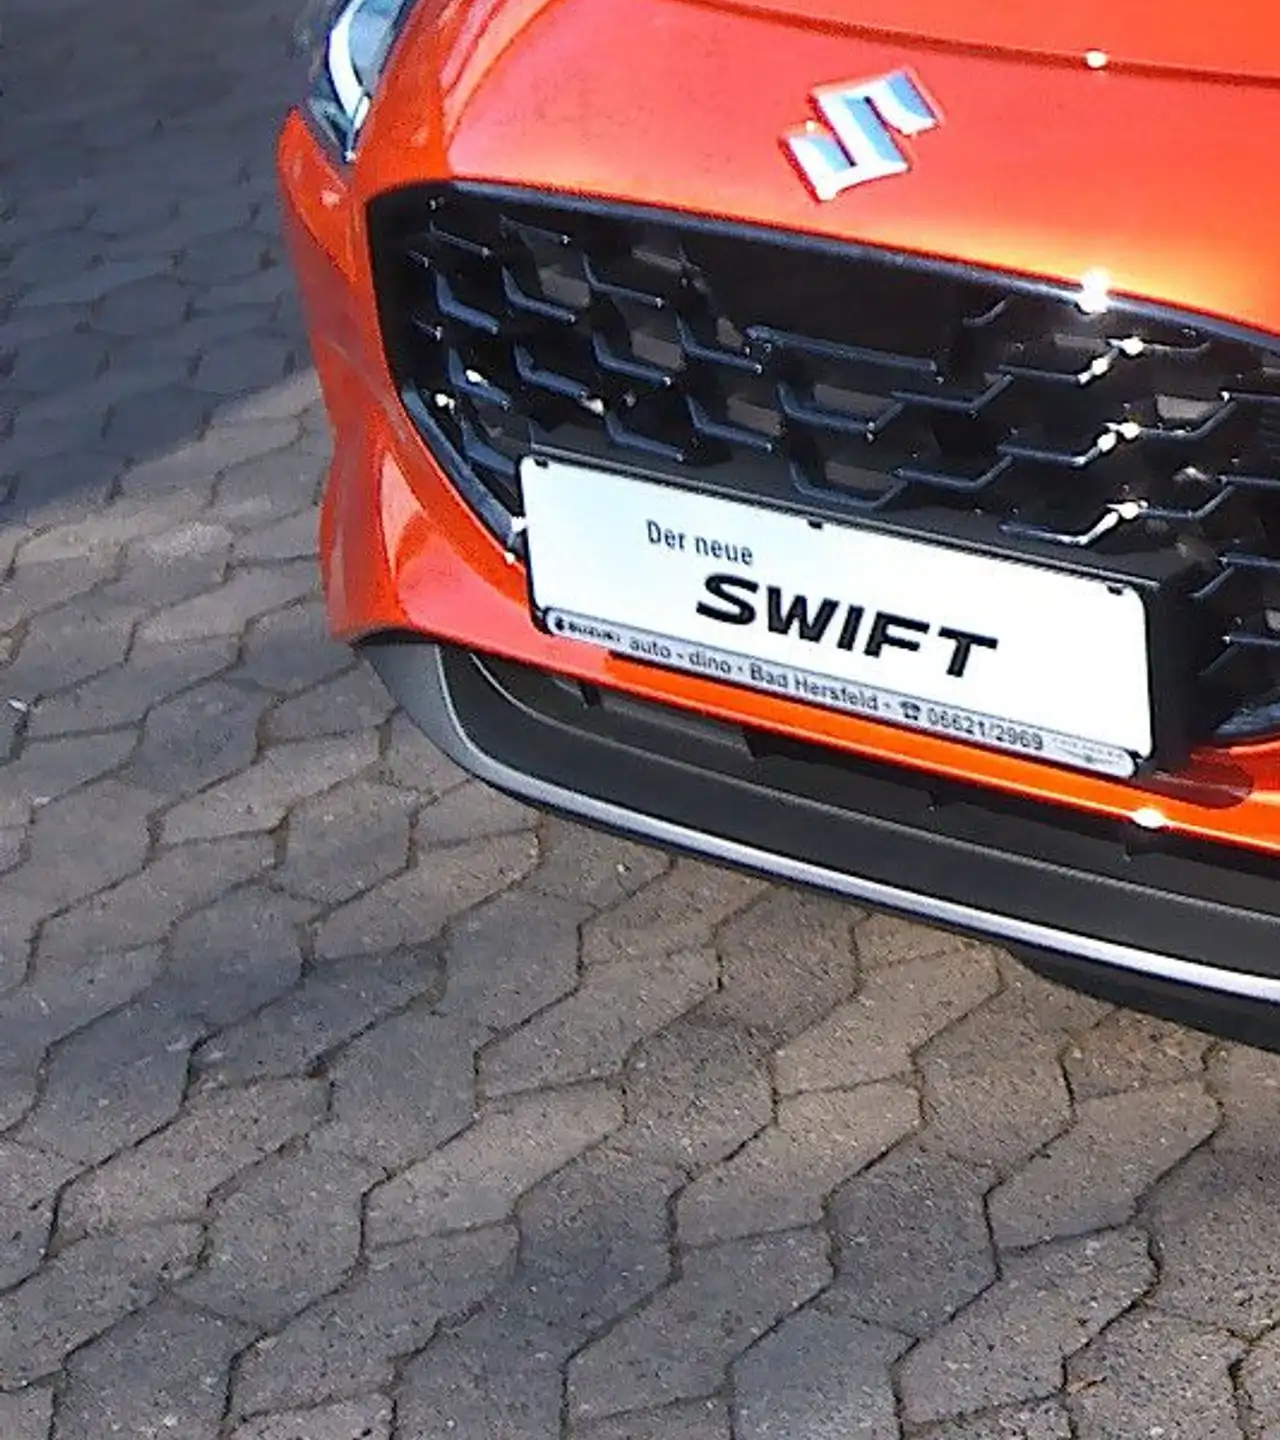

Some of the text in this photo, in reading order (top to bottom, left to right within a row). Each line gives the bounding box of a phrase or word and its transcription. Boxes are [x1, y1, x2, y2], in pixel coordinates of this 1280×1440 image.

[646, 518, 754, 565] Der neue
[696, 572, 999, 679] SWIFT
[629, 636, 672, 659] auto
[688, 650, 732, 675] dino
[750, 662, 789, 688] Bad
[794, 678, 880, 712] Hersfeld
[926, 709, 1043, 751] 06621/2969
